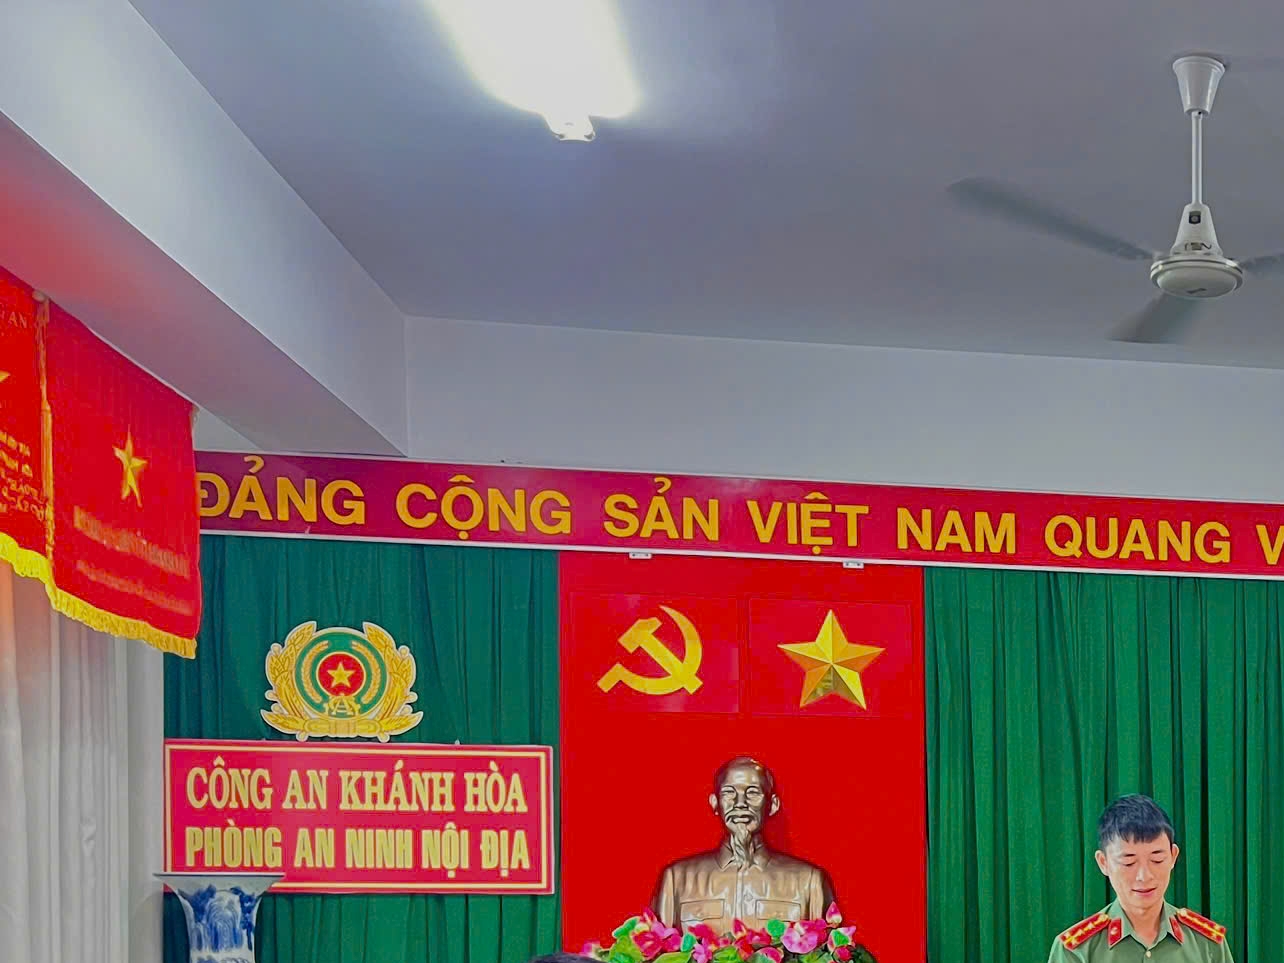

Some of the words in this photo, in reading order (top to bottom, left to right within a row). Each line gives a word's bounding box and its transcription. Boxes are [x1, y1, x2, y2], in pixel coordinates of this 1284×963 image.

[195, 455, 366, 525] ĐẢNG
[395, 474, 572, 541] CỘNG
[603, 476, 720, 541] SẢN
[746, 491, 870, 555] VIỆT
[897, 507, 1017, 554] NAM
[1044, 513, 1232, 564] QUANG
[186, 755, 274, 810] CÔNG
[282, 769, 330, 810] AN
[339, 759, 454, 812] KHÁNH
[463, 761, 529, 813] HÒA
[185, 819, 283, 869] PHÒNG
[294, 827, 336, 869] AN
[345, 828, 413, 870] NINH
[421, 822, 470, 878] NỘI
[480, 829, 531, 877] ĐỊA
